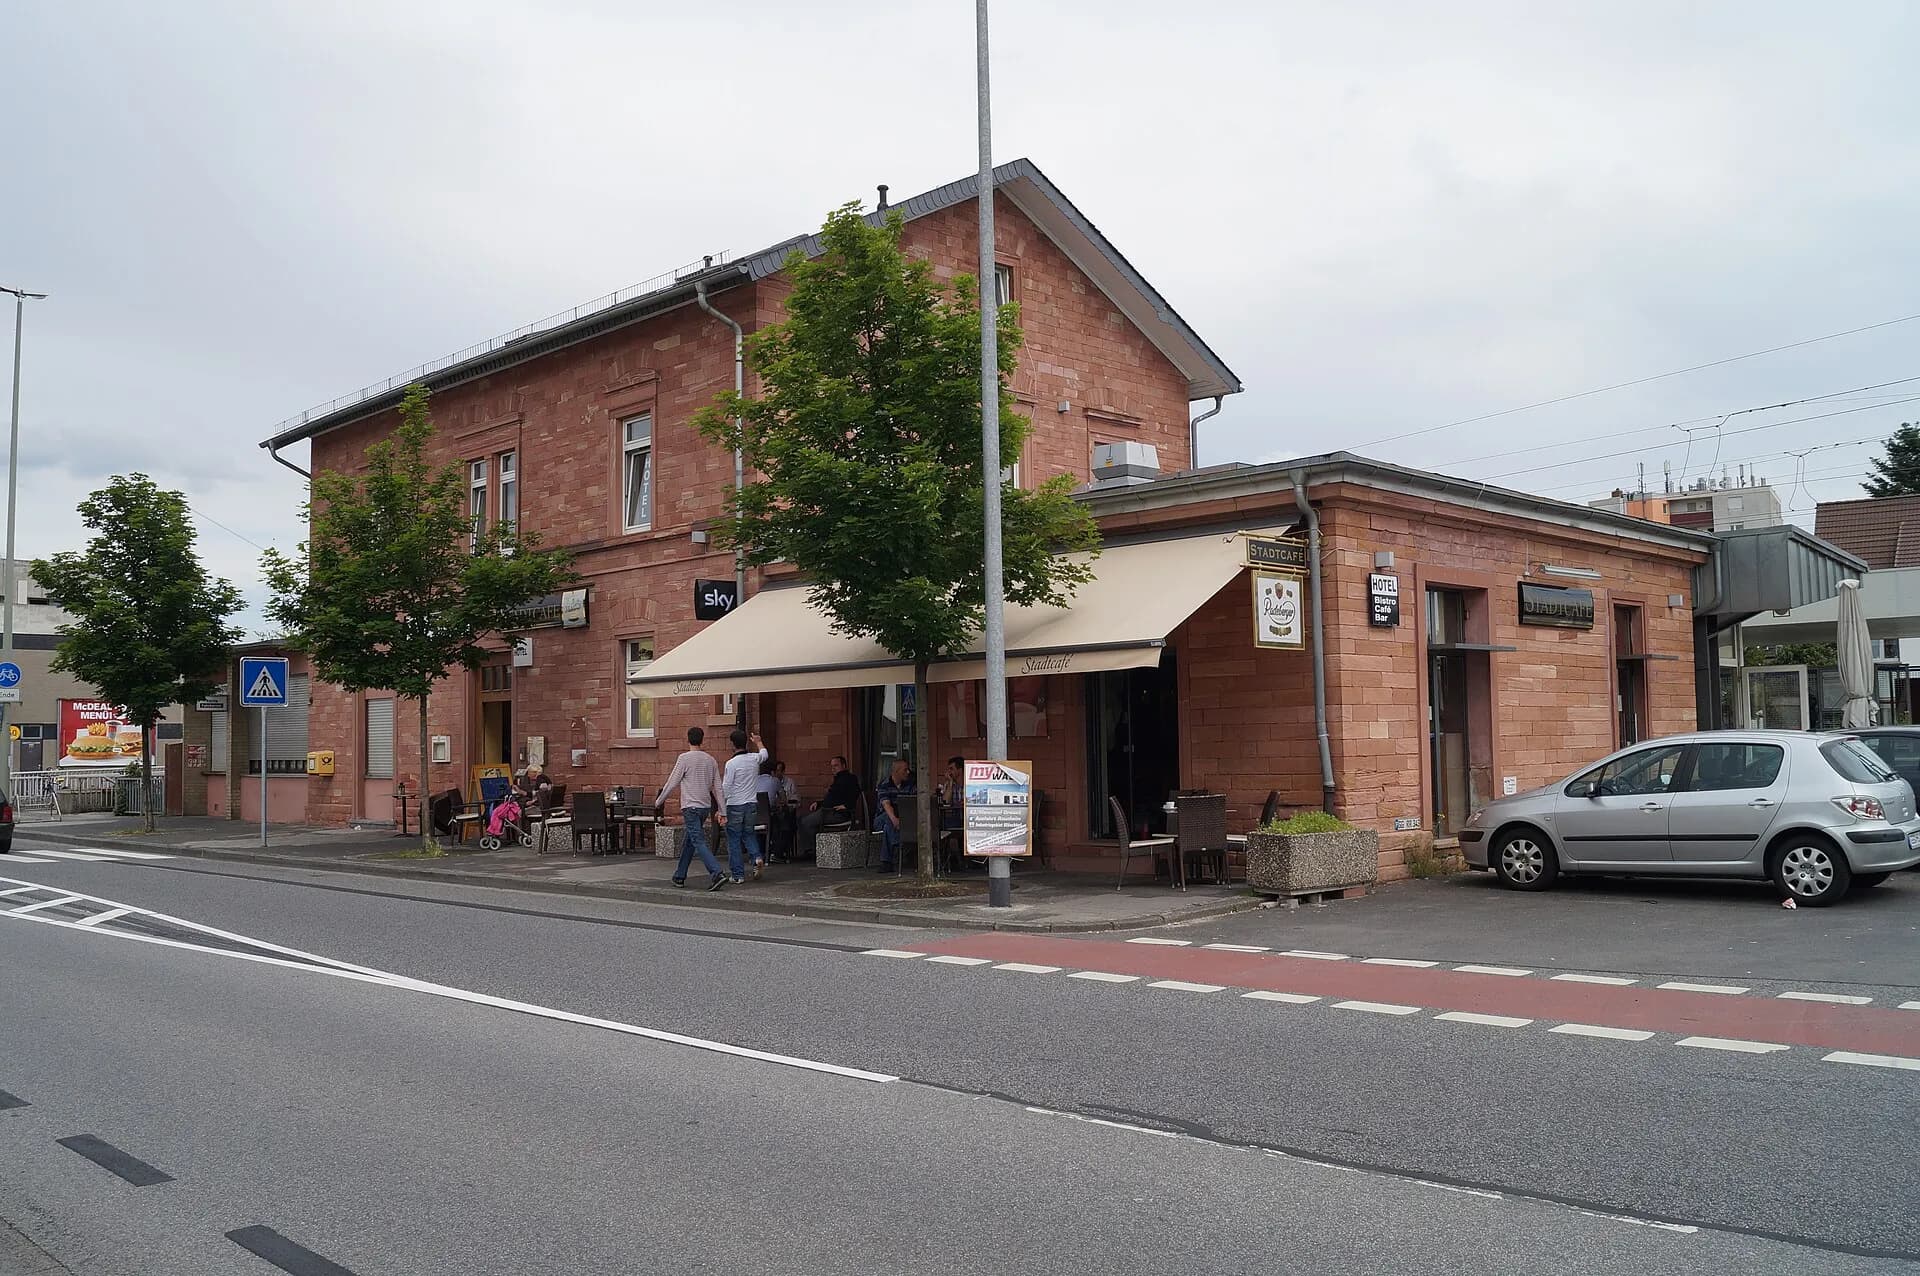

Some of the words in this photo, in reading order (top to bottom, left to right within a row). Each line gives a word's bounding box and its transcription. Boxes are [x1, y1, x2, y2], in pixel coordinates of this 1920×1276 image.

[641, 456, 651, 518] HOTEL
[1250, 543, 1304, 562] STADTCAFÉ
[1373, 578, 1396, 592] HOTEL
[704, 589, 734, 611] sky
[1374, 596, 1396, 605] Bistro
[1374, 604, 1391, 613] Café
[1375, 613, 1388, 622] Bar
[1021, 652, 1074, 674] Stadtcafé
[73, 703, 112, 711] McDEAL
